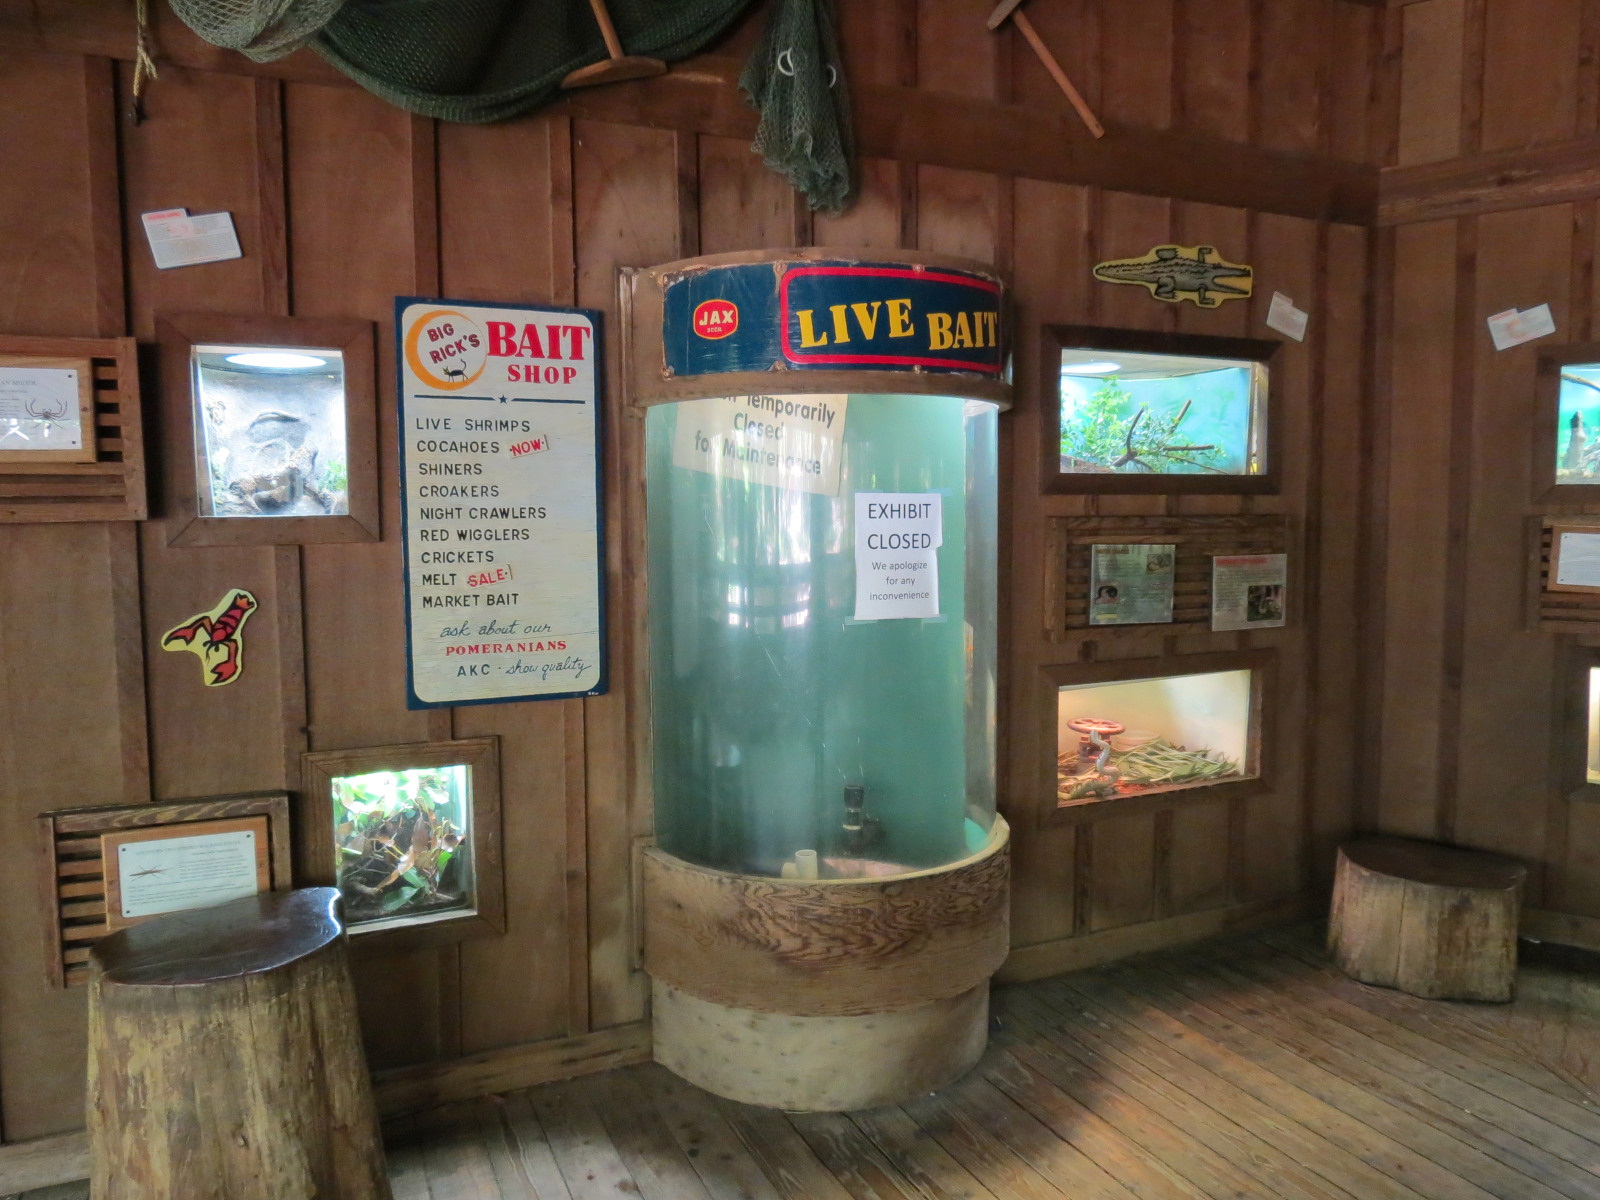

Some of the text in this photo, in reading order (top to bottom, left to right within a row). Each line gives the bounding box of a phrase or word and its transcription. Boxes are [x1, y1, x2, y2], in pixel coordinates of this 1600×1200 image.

[699, 310, 734, 326] JAX
[796, 298, 998, 350] LIVE BAIT
[427, 323, 455, 342] BIG
[485, 321, 591, 360] BAIT
[429, 334, 481, 364] RICK'S
[507, 364, 577, 384] SHOP
[416, 418, 530, 432] LIVE SHRIMPS
[734, 412, 784, 441] Closed
[417, 439, 541, 456] COCAHOES NOW
[722, 437, 821, 475] Maintenace
[419, 463, 483, 475] SHINERS
[419, 485, 500, 498] CROAKERS
[420, 507, 547, 520] NIGHT CRAWLERS
[868, 503, 931, 519] EXHIBIT
[420, 528, 530, 541] RED WIGGLERS
[867, 533, 931, 550] CLOSED
[421, 551, 495, 564] CRICKETS
[872, 561, 928, 571] We apologize
[422, 568, 505, 587] MELT SALE
[886, 577, 915, 586] for any
[422, 593, 519, 608] MARKET BAIT
[869, 592, 930, 600] inconvenience
[440, 619, 553, 638] ask about our
[445, 640, 567, 656] POMERANIANS
[457, 656, 592, 680] AKC show quality
